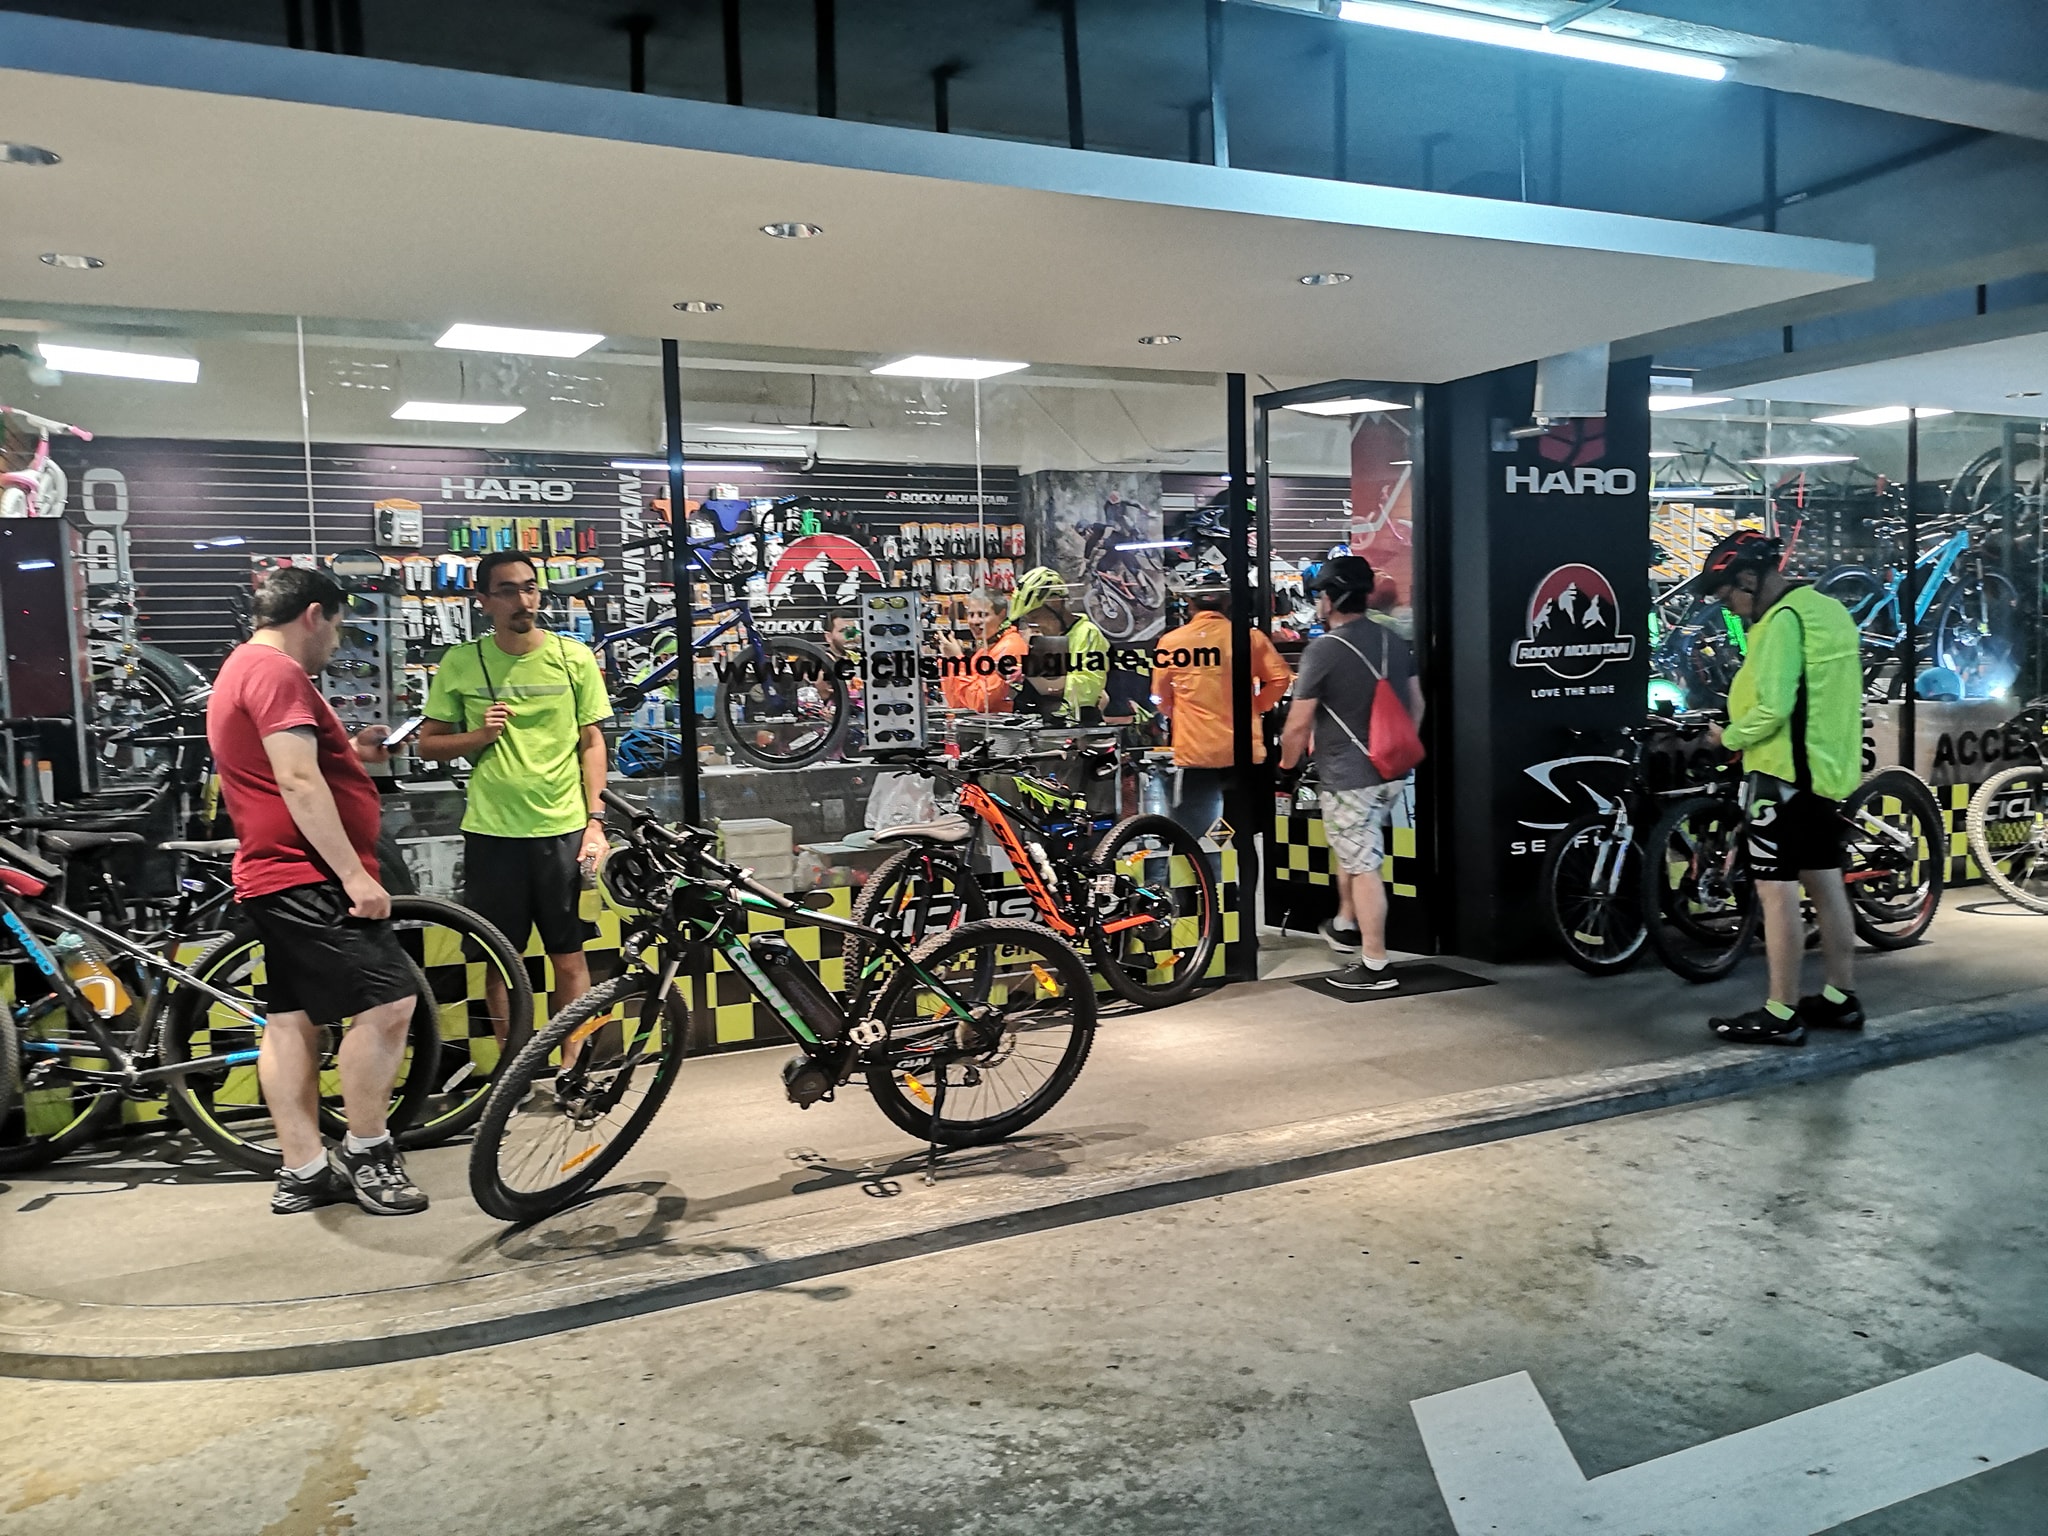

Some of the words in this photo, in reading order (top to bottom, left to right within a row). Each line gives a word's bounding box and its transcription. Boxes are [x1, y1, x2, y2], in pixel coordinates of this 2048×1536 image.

[441, 477, 574, 502] HARO
[1505, 466, 1637, 495] HARO
[901, 492, 943, 504] ROCKY
[944, 494, 1009, 506] MOUNTAIN
[1519, 646, 1563, 660] ROCKY
[1564, 642, 1630, 657] MOUNTAIN
[1531, 688, 1561, 699] LOVE
[1564, 687, 1586, 696] THE
[1589, 685, 1615, 695] RIDE
[992, 822, 1060, 922] SCOTT
[727, 946, 797, 1019] GIANT
[896, 1056, 932, 1069] GIA
